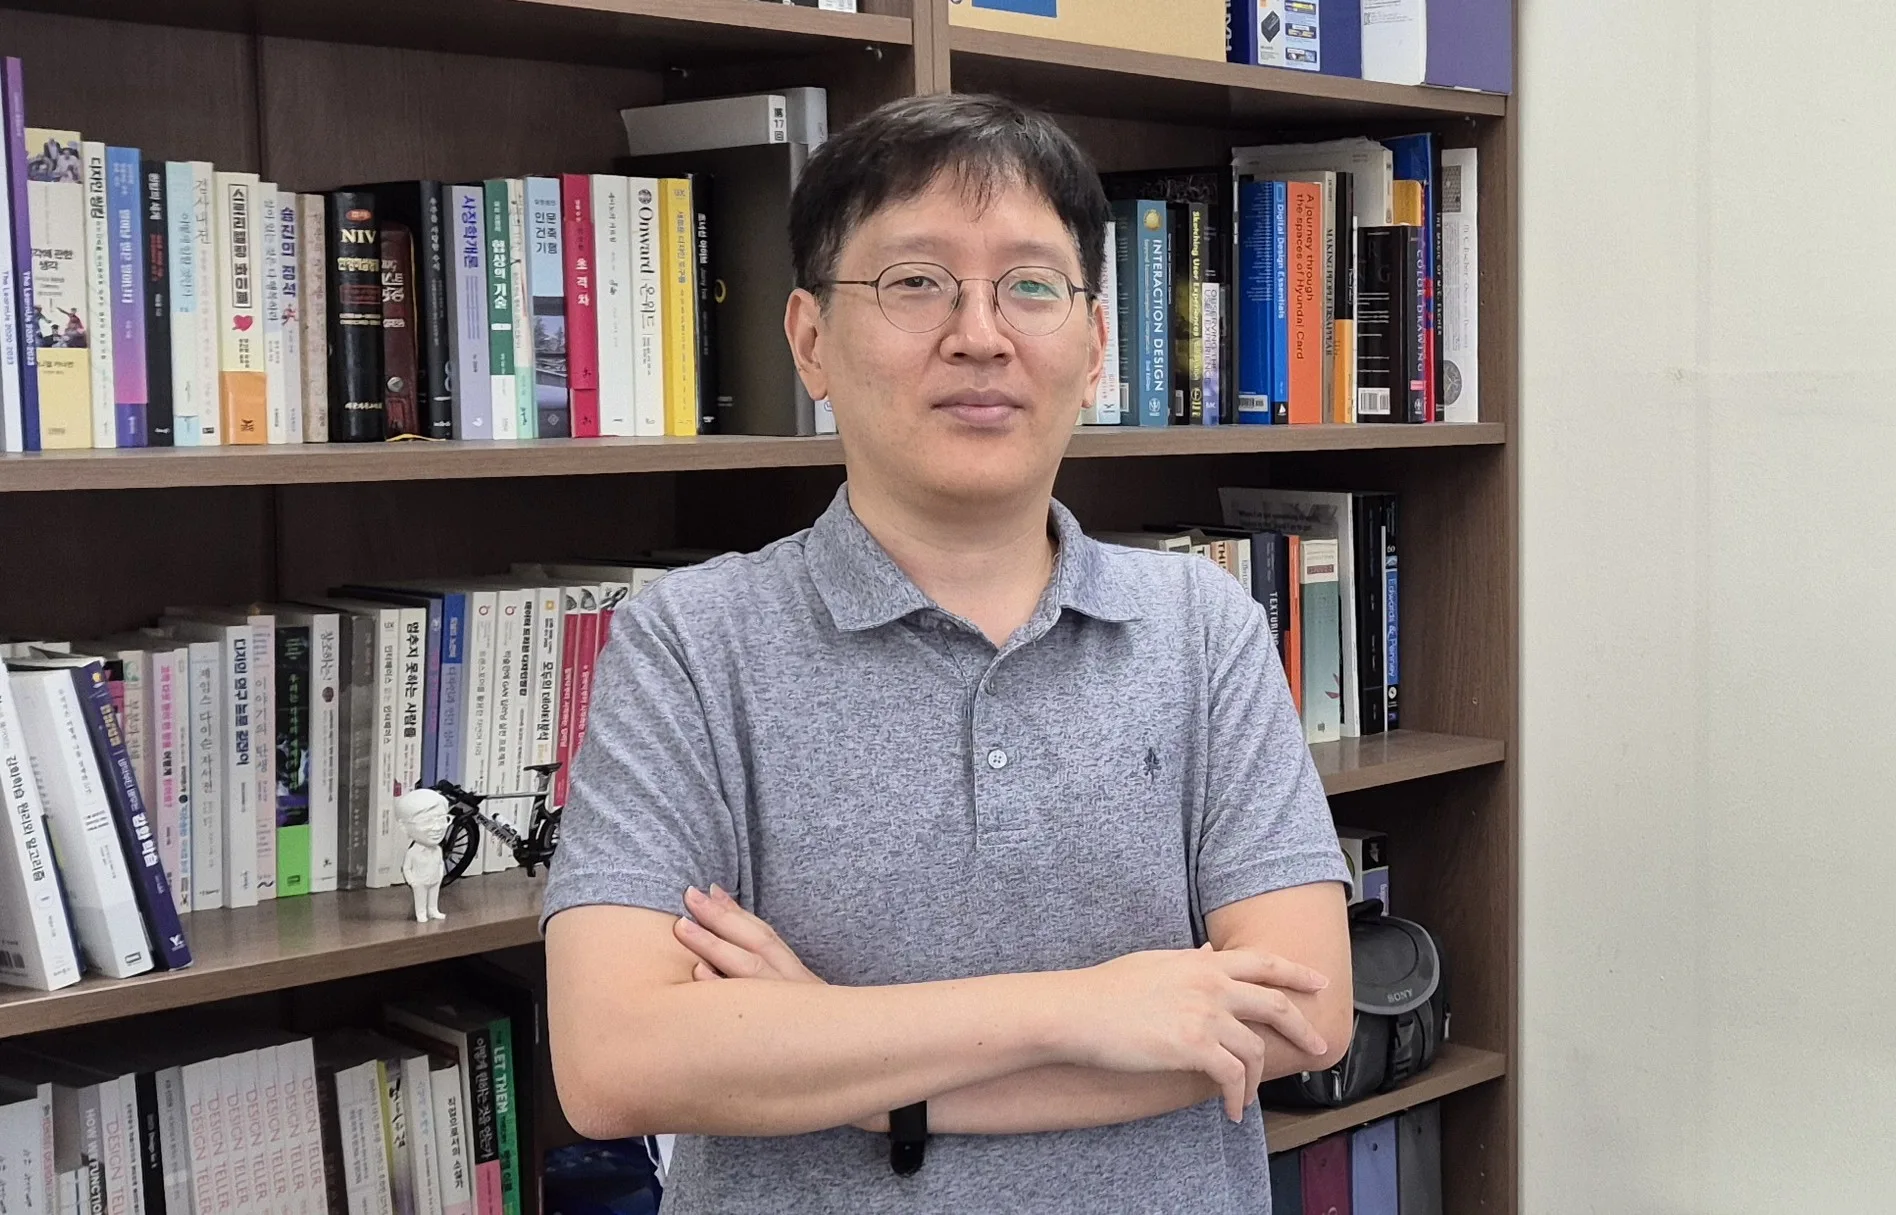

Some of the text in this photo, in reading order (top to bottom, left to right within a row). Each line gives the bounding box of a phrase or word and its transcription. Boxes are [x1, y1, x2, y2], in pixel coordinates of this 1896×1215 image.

[89, 157, 105, 219] 디자인 씽킹
[534, 212, 558, 225] 인문
[281, 207, 297, 297] 승진의 정석
[340, 229, 377, 243] NIV
[461, 195, 479, 268] 사장학개론
[535, 227, 558, 240] 건축
[536, 242, 559, 255] 기행
[637, 206, 655, 273] Onward
[1277, 204, 1286, 319] Digital Design Essentials
[1305, 194, 1314, 301] A journey through
[23, 271, 31, 286] The
[235, 263, 249, 304] 바이블
[492, 239, 508, 309] 협상의 기술
[1191, 211, 1202, 337] Sketching User Experiences
[1295, 194, 1305, 360] the spaces of Hyundai Card
[1436, 265, 1442, 275] OF
[639, 283, 656, 329] 온워드
[1152, 238, 1164, 391] INTERACTION DESIGN
[1325, 305, 1333, 355] DISAPPEAR
[1416, 249, 1425, 373] COLOR DRAWING
[1387, 578, 1397, 622] Edwards
[402, 620, 420, 739] 멈추지 못하는 사람들
[501, 680, 510, 698] GAN
[538, 660, 553, 690] 모두의
[1387, 638, 1397, 676] Penney
[233, 637, 249, 766] 디자인 연구 논문 길잡이
[1386, 988, 1413, 1004] SONY
[491, 1044, 509, 1114] LET THEM
[106, 1115, 124, 1181] DESIGN
[190, 1102, 206, 1160] DESIGN
[207, 1096, 230, 1212] DESIGN TELLER
[226, 1091, 249, 1208] DESIGN TELLER
[246, 1086, 267, 1203] DESIGN TELLER
[265, 1082, 286, 1199] DESIGN TELLER
[284, 1079, 305, 1193] DESIGN TELLER
[302, 1077, 322, 1189] DESIGN TELLER
[89, 1160, 104, 1215] FUNCTIO
